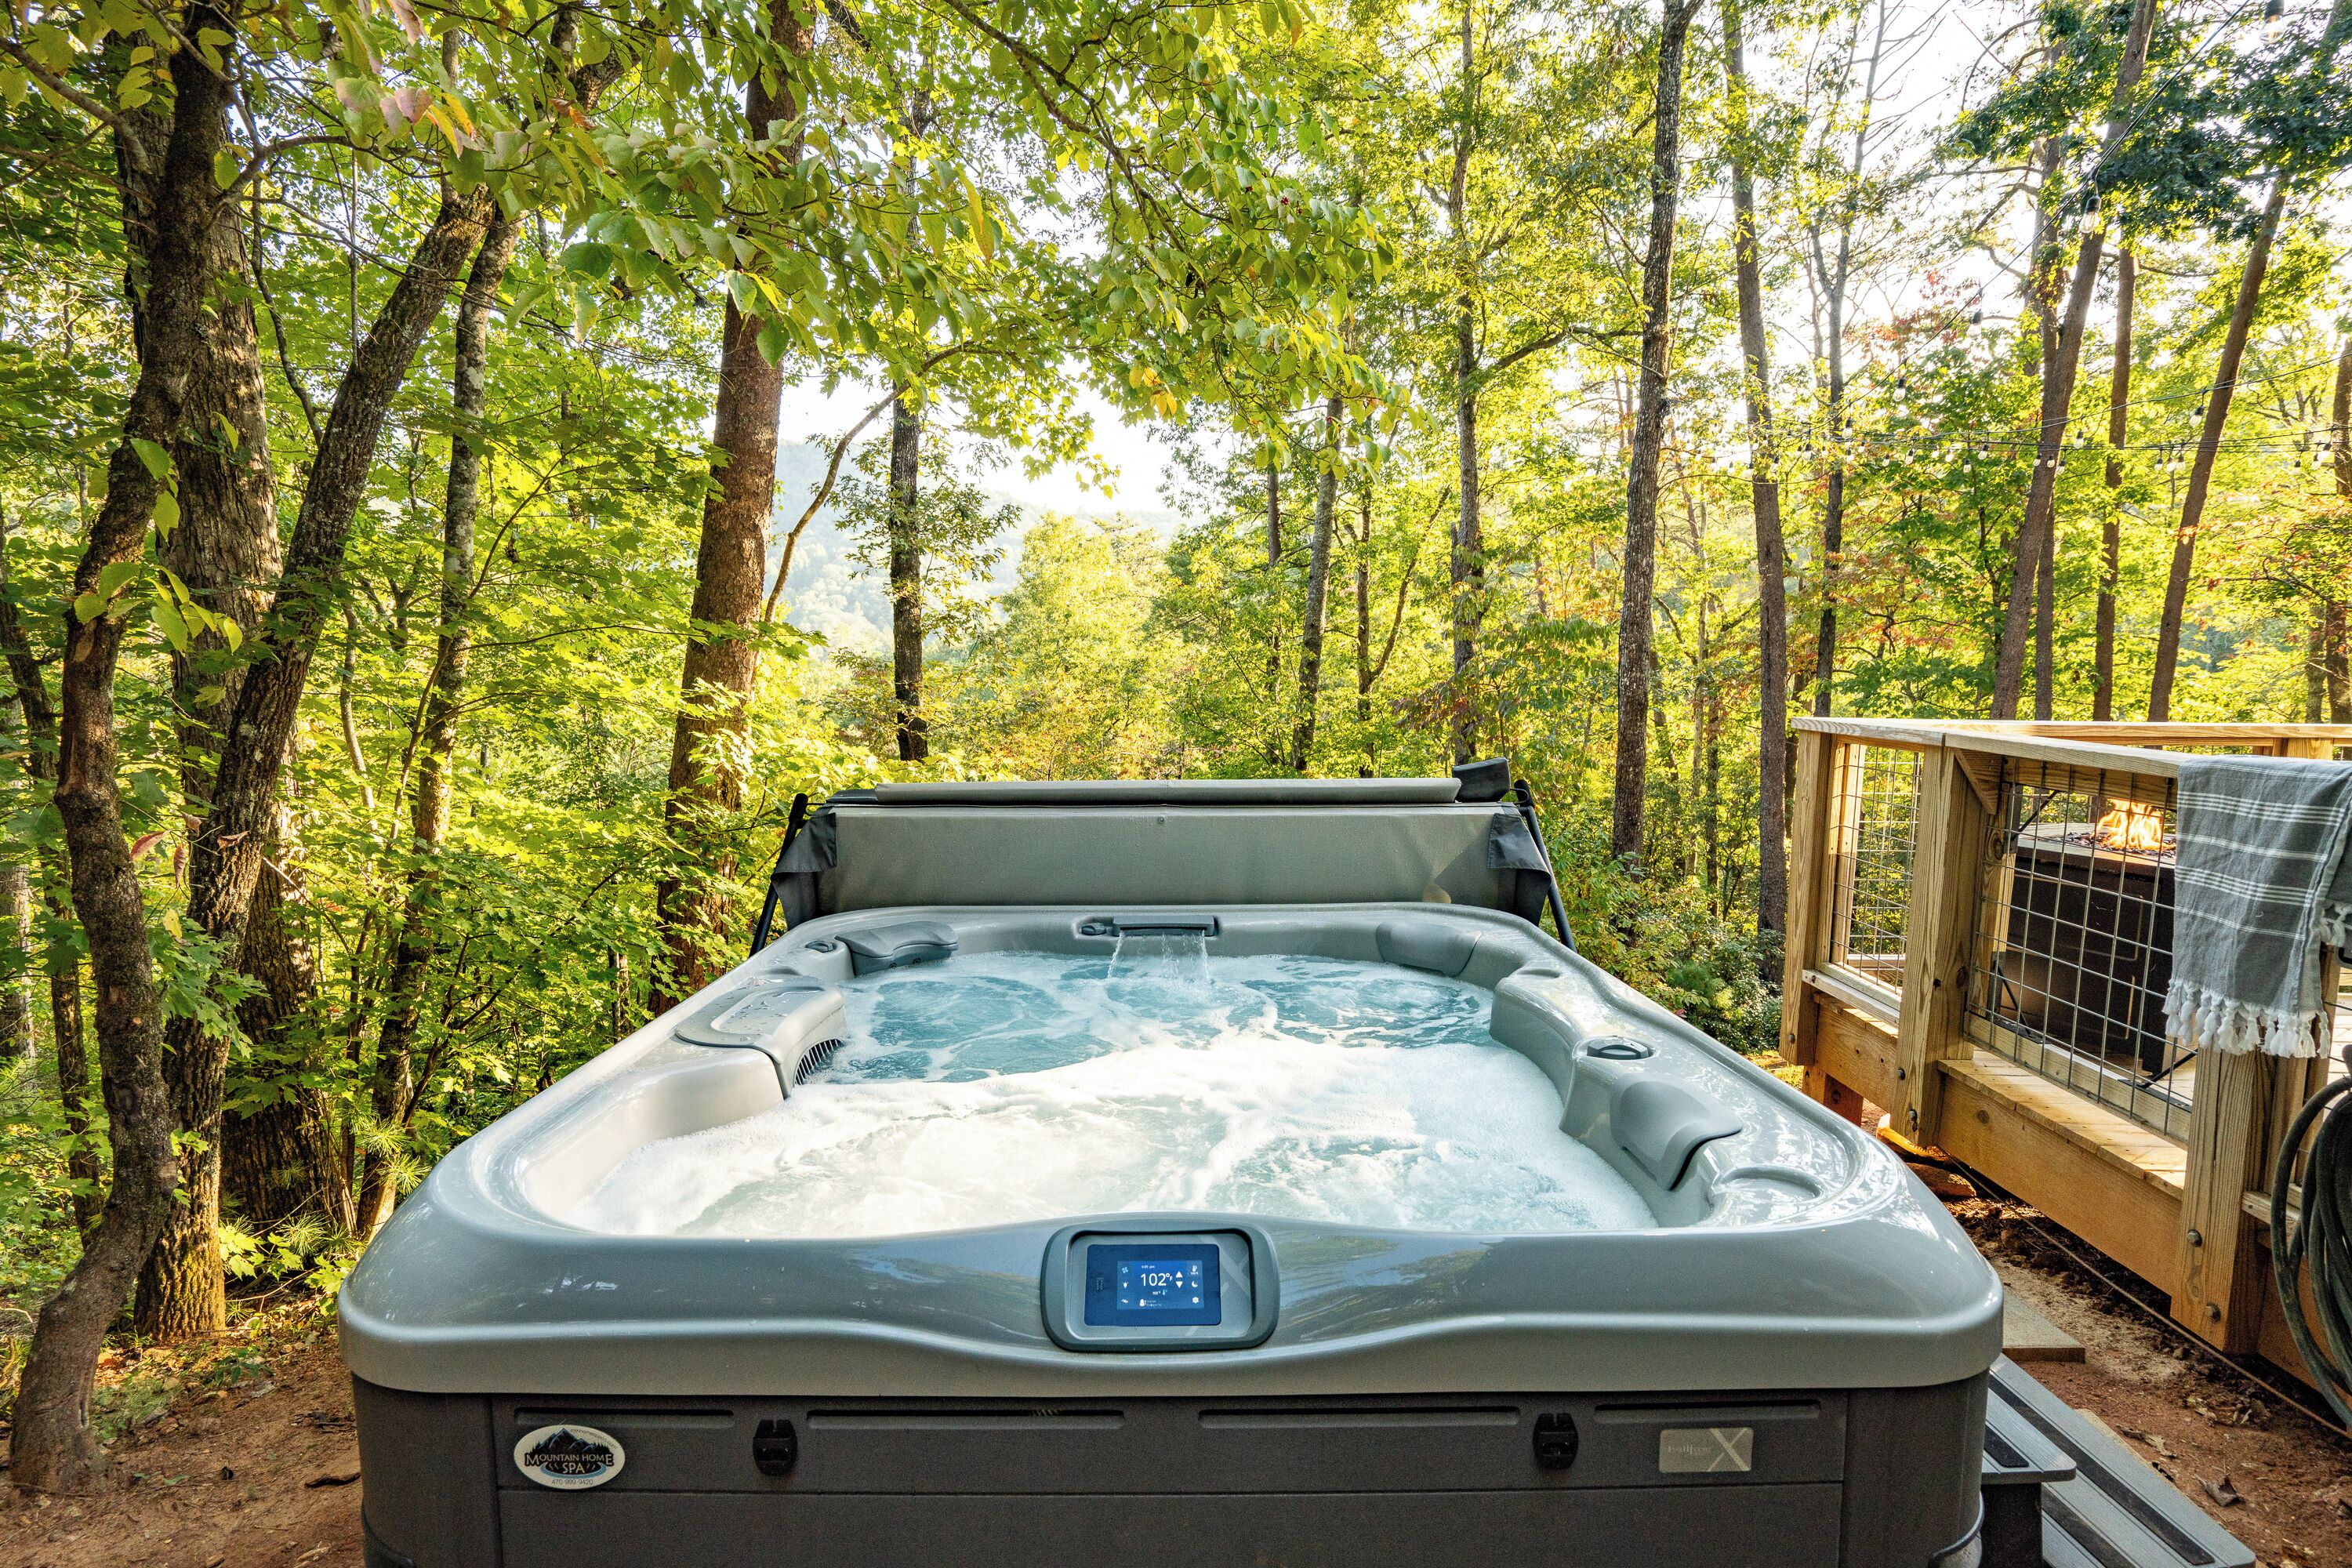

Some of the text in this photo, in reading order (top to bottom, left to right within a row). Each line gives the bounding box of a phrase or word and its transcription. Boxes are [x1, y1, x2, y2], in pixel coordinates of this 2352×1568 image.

[526, 1454, 612, 1466] MOUNTAIN HOME
[562, 1463, 585, 1473] SPA
